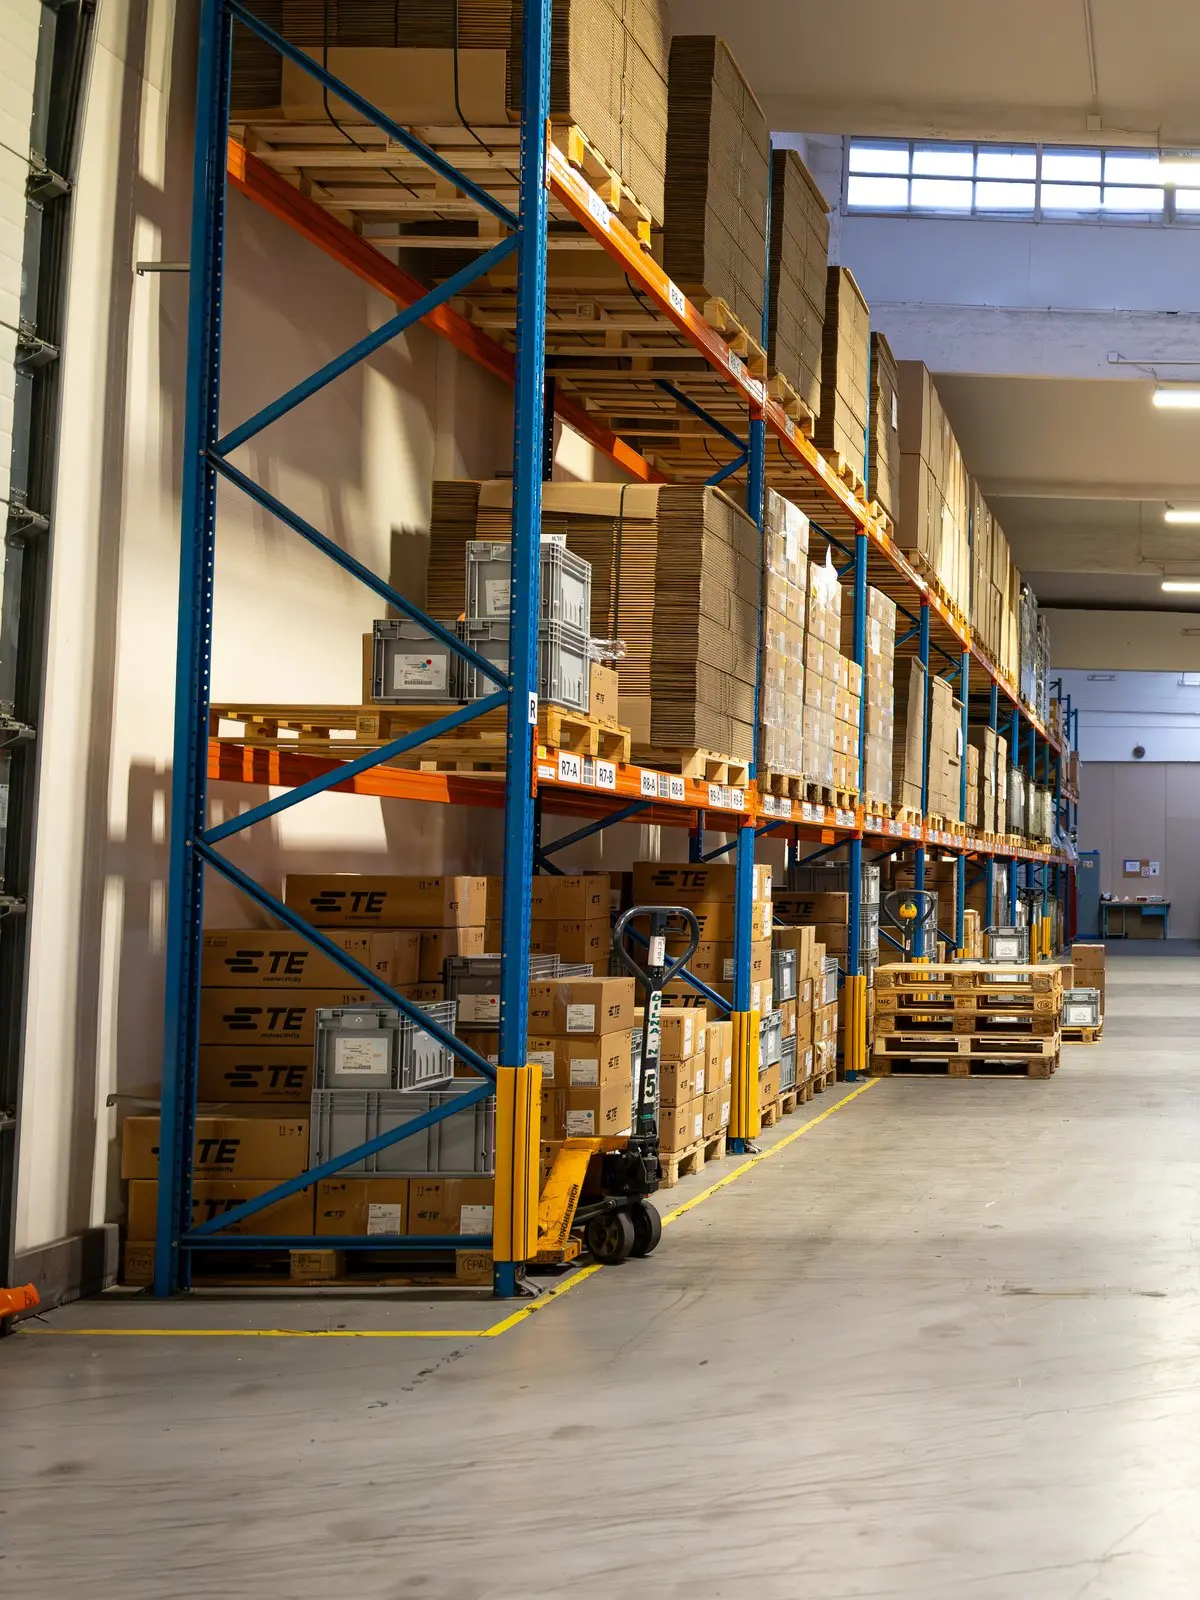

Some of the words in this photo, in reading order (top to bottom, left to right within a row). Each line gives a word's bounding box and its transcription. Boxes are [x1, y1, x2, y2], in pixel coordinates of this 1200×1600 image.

[530, 700, 536, 719] R
[561, 759, 577, 778] R7-A
[599, 768, 613, 784] R7-B
[642, 777, 656, 791] R8-A
[671, 782, 683, 796] R8-B
[710, 789, 721, 802] R9-A
[681, 871, 708, 887] TE
[350, 891, 387, 912] TE
[795, 901, 815, 913] TE
[268, 952, 309, 974] TE
[267, 1008, 306, 1030] TE
[268, 1065, 307, 1088] TE
[644, 1073, 656, 1098] 5
[198, 1139, 240, 1163] TE
